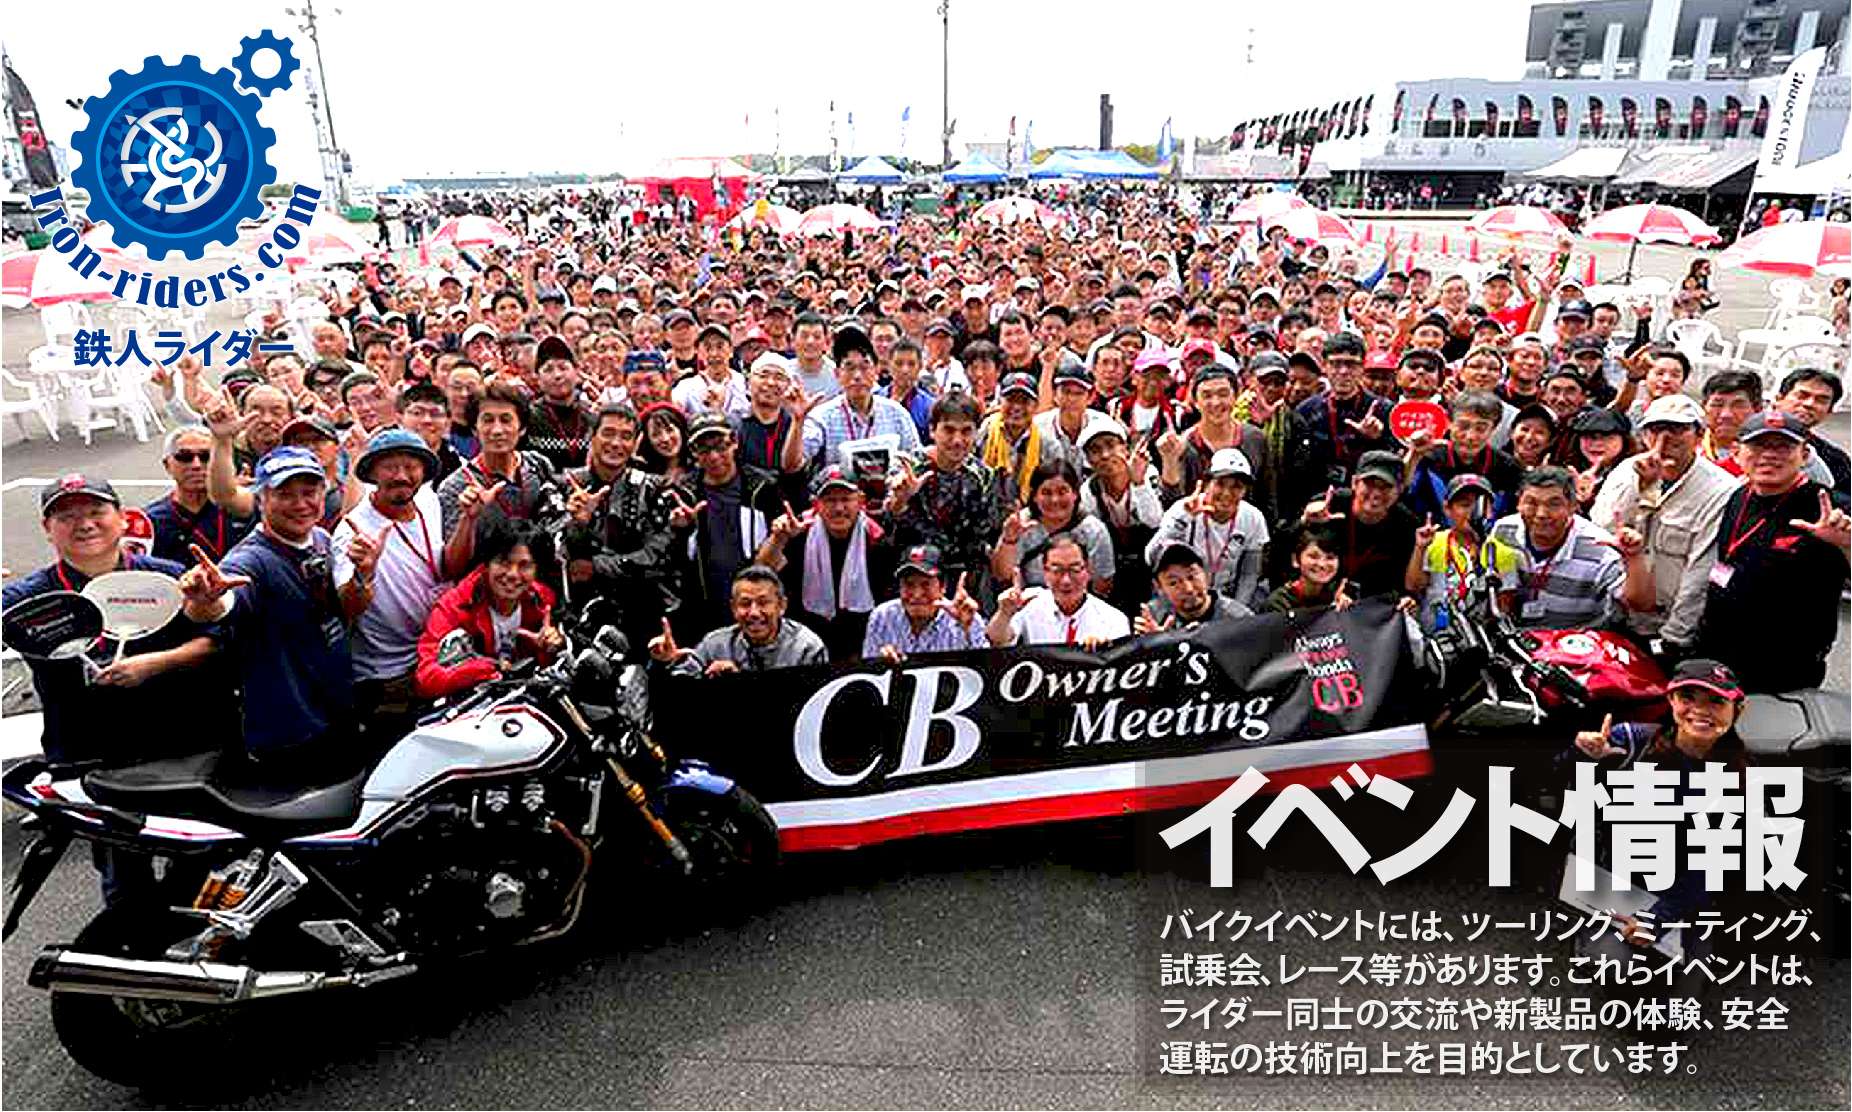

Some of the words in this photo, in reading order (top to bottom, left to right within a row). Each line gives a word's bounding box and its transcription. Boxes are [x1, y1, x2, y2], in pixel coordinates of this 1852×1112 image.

[1000, 642, 1210, 703] Owner's
[1312, 673, 1364, 713] CB
[794, 665, 985, 787] CB
[1062, 691, 1274, 747] Meeting
